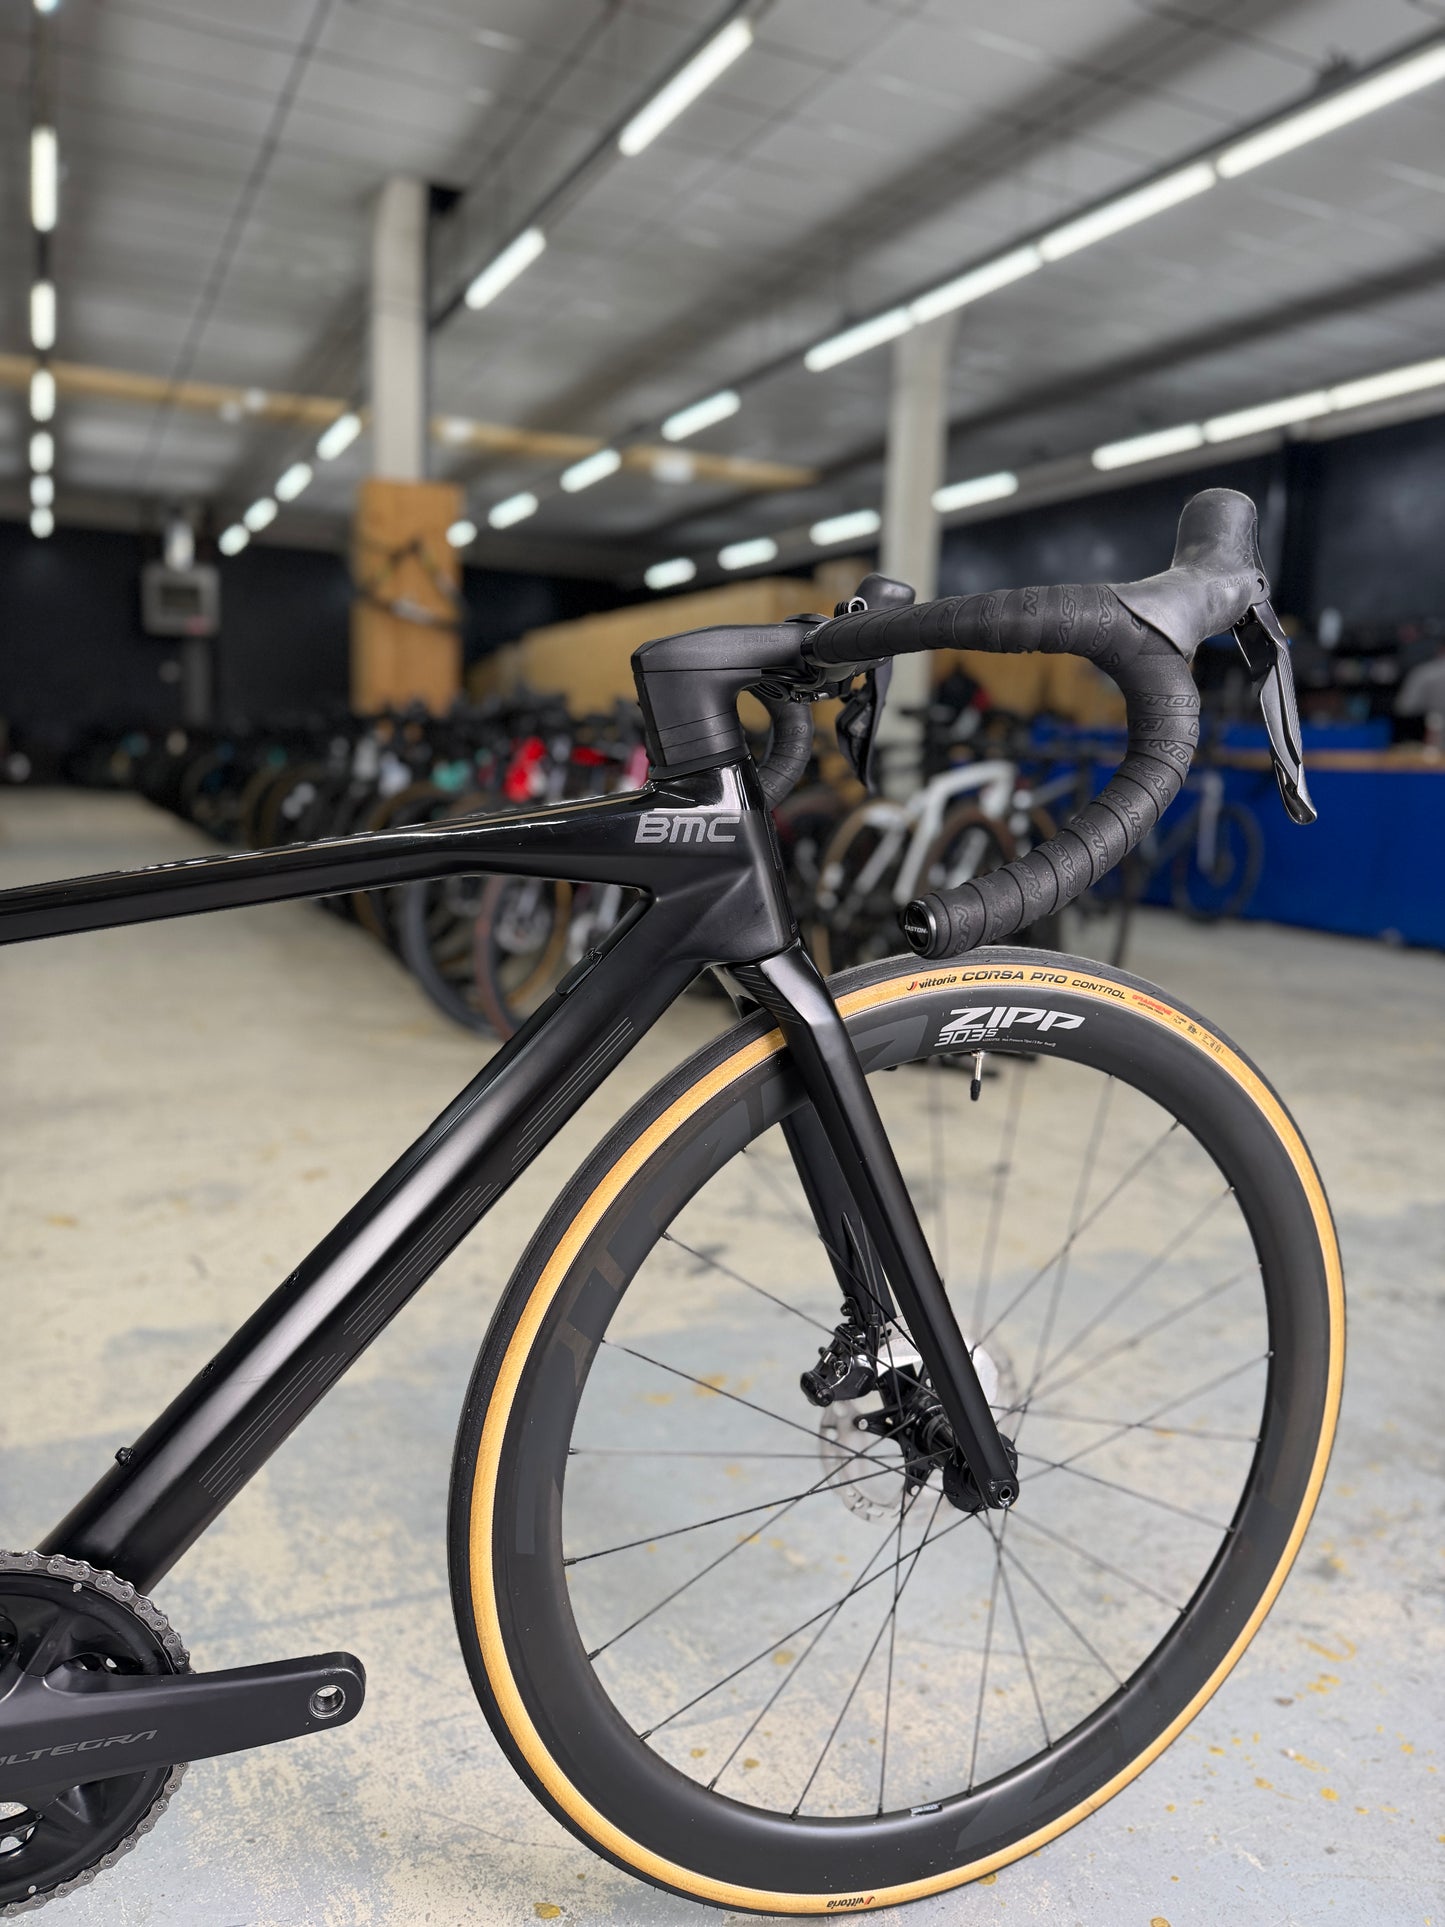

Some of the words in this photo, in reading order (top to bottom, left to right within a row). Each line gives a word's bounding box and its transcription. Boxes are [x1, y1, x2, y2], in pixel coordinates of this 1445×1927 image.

[634, 814, 741, 844] BMC
[919, 974, 957, 989] vittoria
[961, 970, 1024, 982] CORSA
[1030, 971, 1068, 984] PRO
[1071, 979, 1126, 1000] CONTROL
[941, 1006, 1086, 1032] ZIPP
[0, 1729, 158, 1767] LTEGRA
[826, 1898, 865, 1910] vittoria
